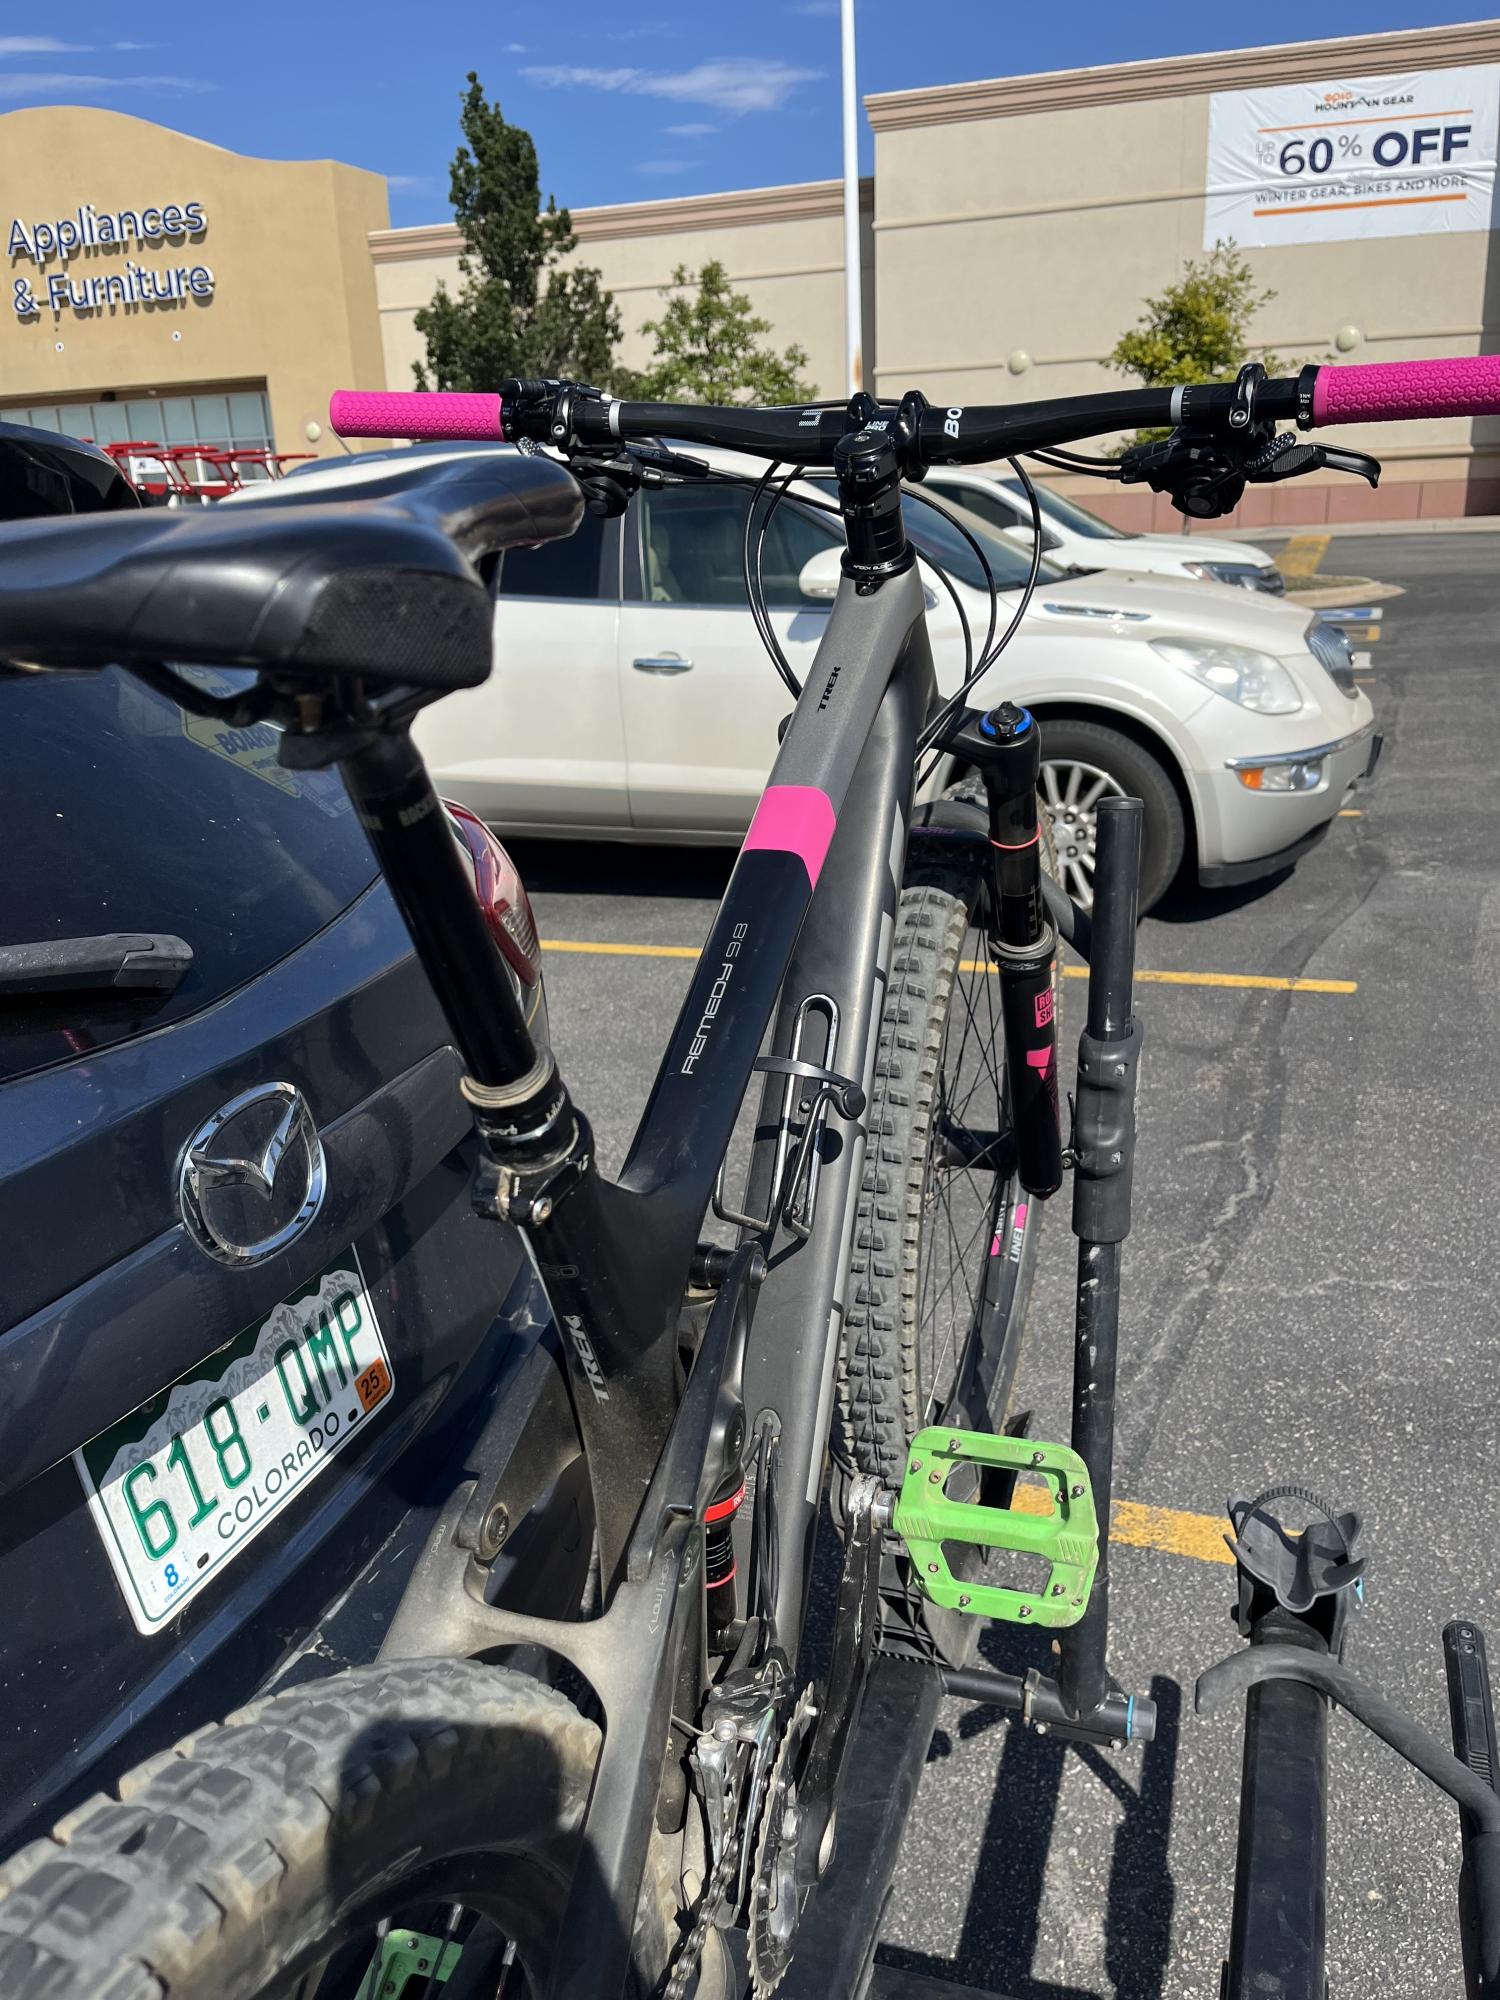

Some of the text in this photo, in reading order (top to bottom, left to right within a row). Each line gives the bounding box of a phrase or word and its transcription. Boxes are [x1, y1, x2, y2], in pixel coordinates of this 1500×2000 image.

[1383, 95, 1414, 105] GEAR
[1256, 141, 1275, 153] UP
[1256, 153, 1275, 165] TO
[1373, 125, 1472, 167] OFF
[1256, 188, 1307, 204] WINTER
[1354, 182, 1391, 195] BIKES
[1396, 179, 1424, 191] AND
[1429, 175, 1468, 187] MORE
[8, 202, 207, 262] Appliances
[13, 261, 215, 315] & Furniture
[817, 666, 841, 713] TREK
[682, 922, 749, 1075] REMEDY 9.8
[1040, 1006, 1053, 1023] SH
[562, 1314, 609, 1404] TREK
[361, 1369, 380, 1400] 25
[217, 1412, 340, 1540] COLORADO
[164, 1563, 179, 1587] 8
